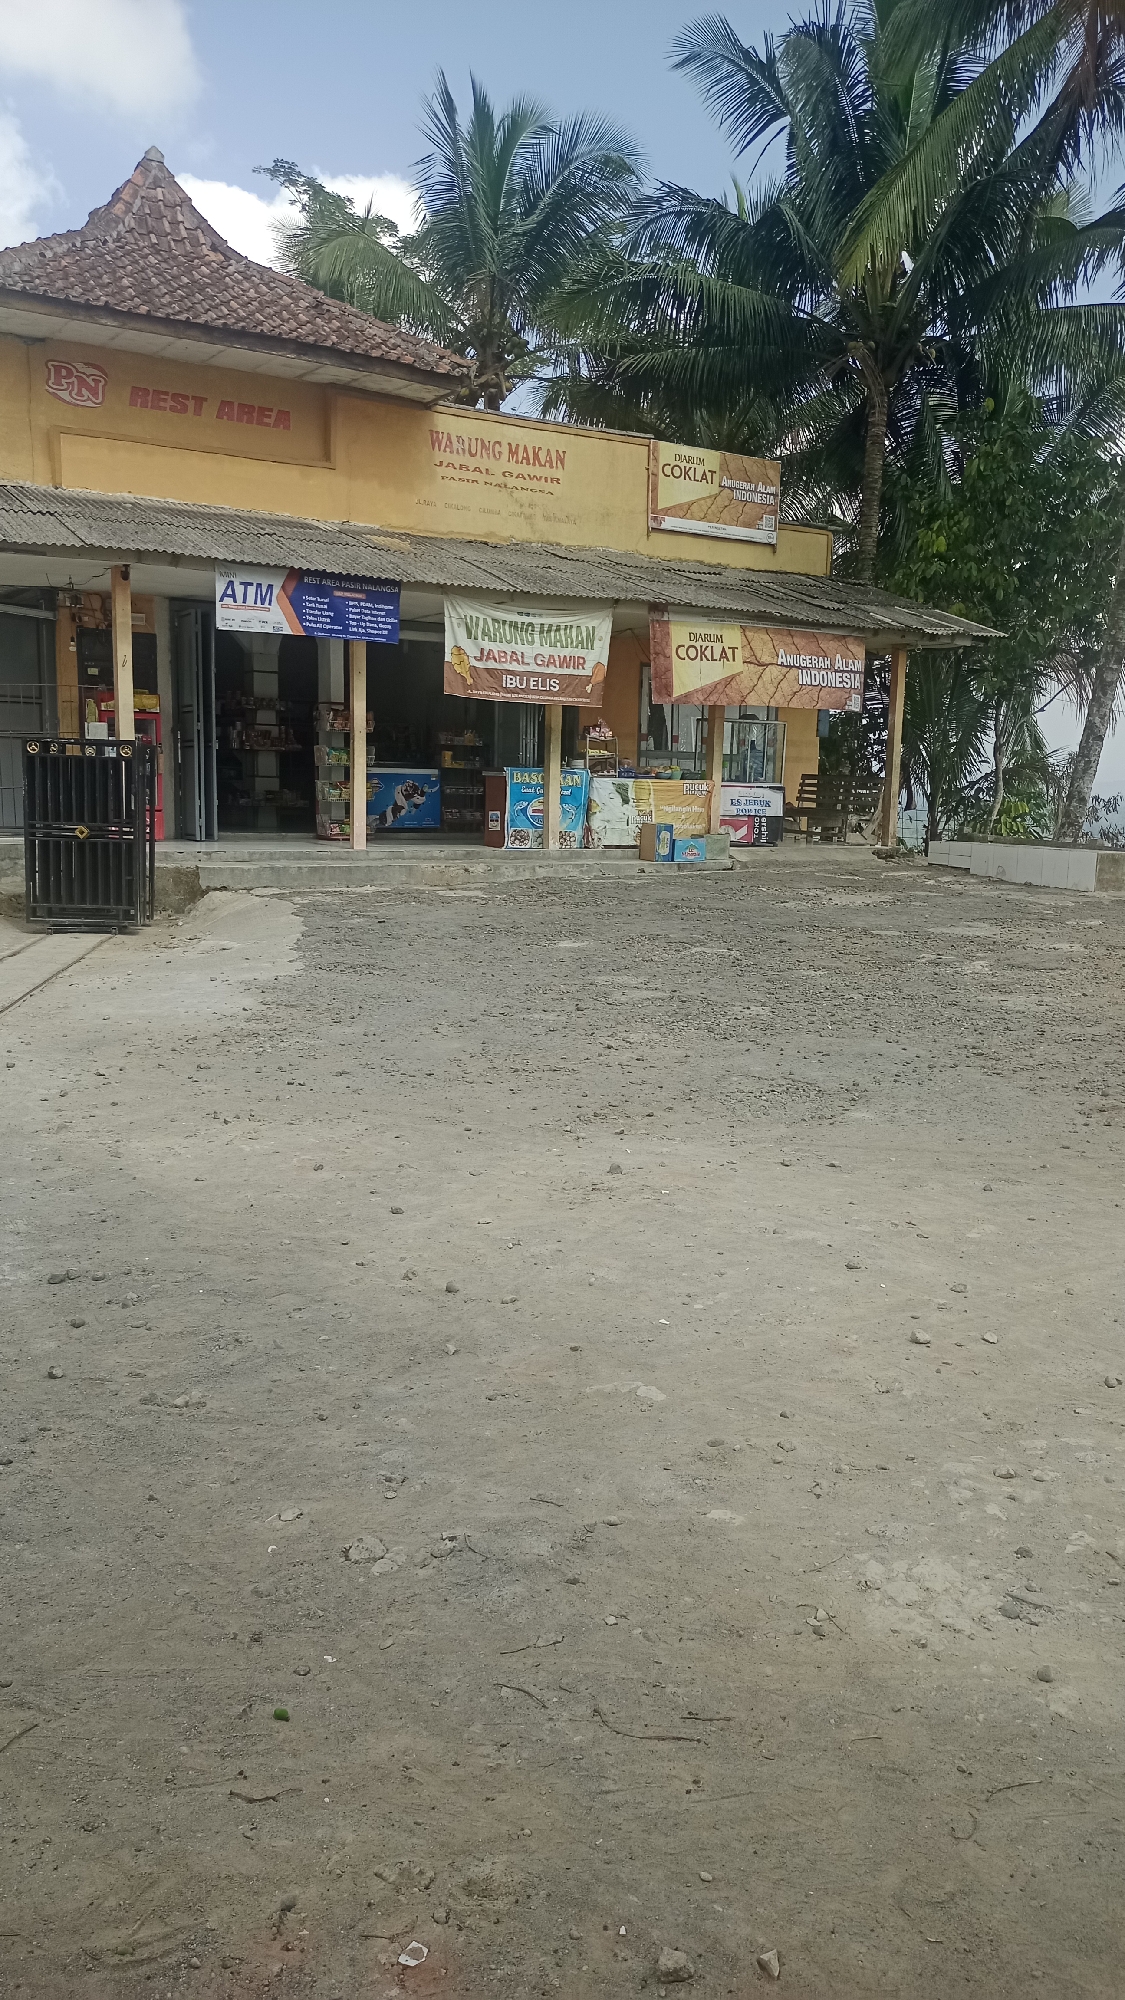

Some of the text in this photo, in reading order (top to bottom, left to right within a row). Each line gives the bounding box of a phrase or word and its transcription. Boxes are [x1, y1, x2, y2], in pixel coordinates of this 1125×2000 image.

[128, 385, 291, 431] REST AREA
[428, 429, 566, 471] WARUNG MAKAN
[674, 453, 705, 467] DJARUM
[433, 460, 561, 485] JABAL GAWIR
[440, 475, 479, 485] PASIR
[661, 463, 716, 485] COKLAT
[733, 489, 775, 506] INDONESIA
[218, 580, 274, 607] ATM
[303, 575, 399, 593] REST AREA PASIR NALANGSA
[463, 614, 596, 651] WARUNG MAKAN
[688, 631, 724, 644] DJARUM
[474, 647, 587, 671] JABAL GAWIR
[675, 644, 738, 663] COKLAT
[834, 653, 862, 672] ALAM
[502, 674, 560, 692] IBU ELIS
[797, 669, 862, 690] INDONESIA
[683, 781, 709, 795] pucuk
[729, 798, 772, 808] ES JERUK
